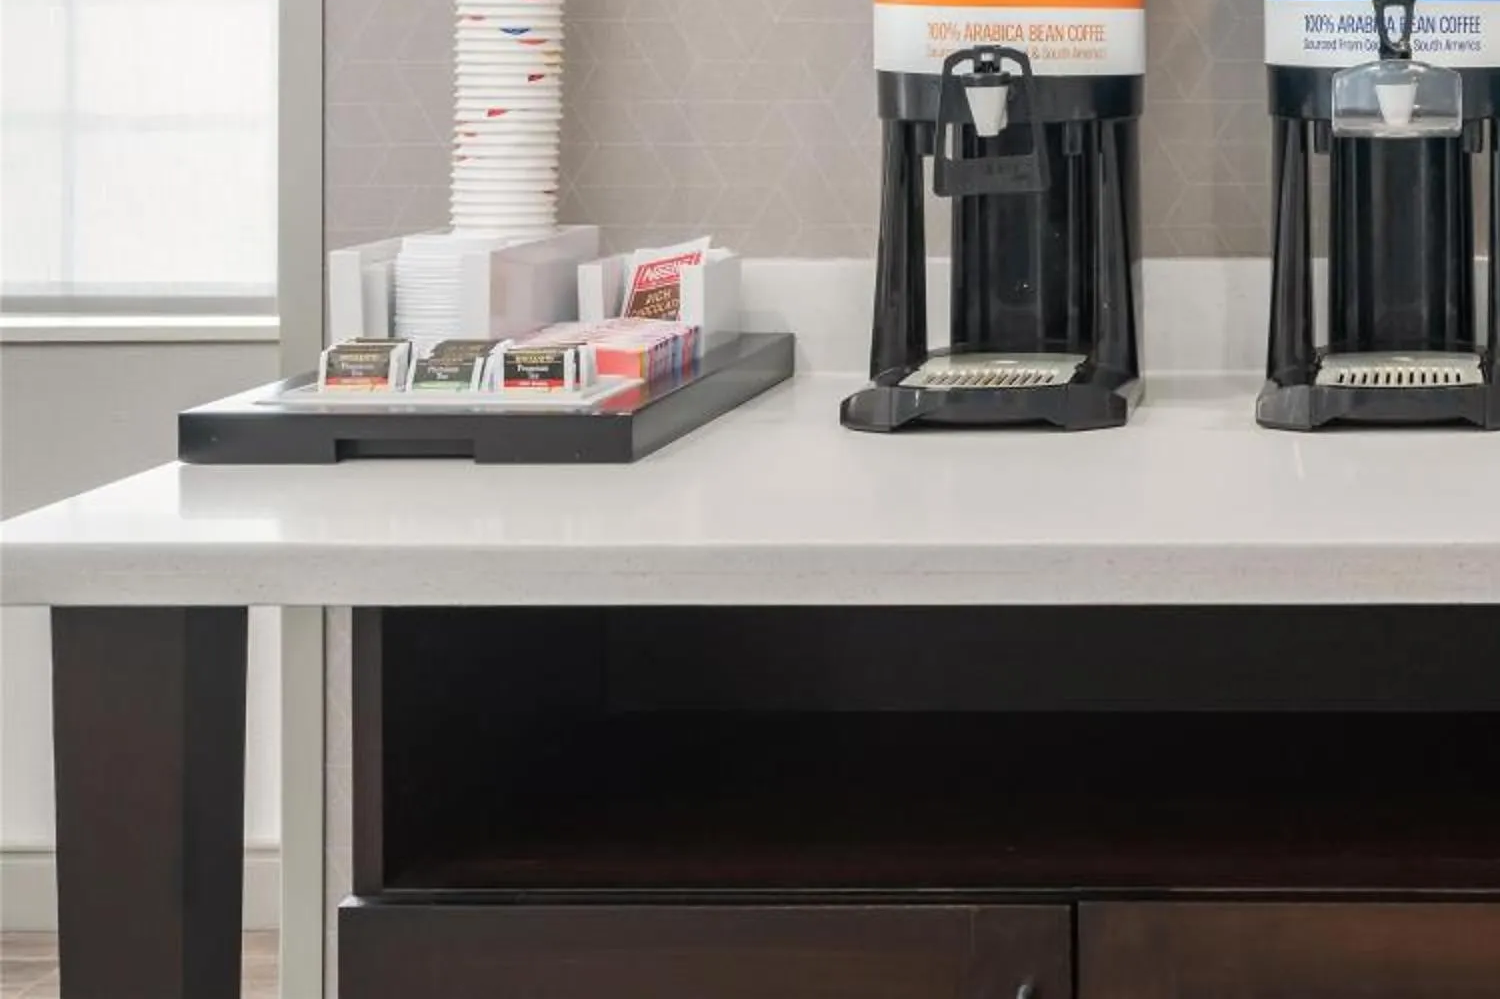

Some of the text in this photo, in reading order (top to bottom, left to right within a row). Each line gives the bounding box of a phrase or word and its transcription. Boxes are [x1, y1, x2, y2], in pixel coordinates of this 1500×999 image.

[928, 22, 1107, 42] 100% ARABICA BEAN COFFEE
[1304, 14, 1335, 34] 100%
[1337, 15, 1396, 33] ARABIA
[1439, 16, 1481, 34] COFFEE
